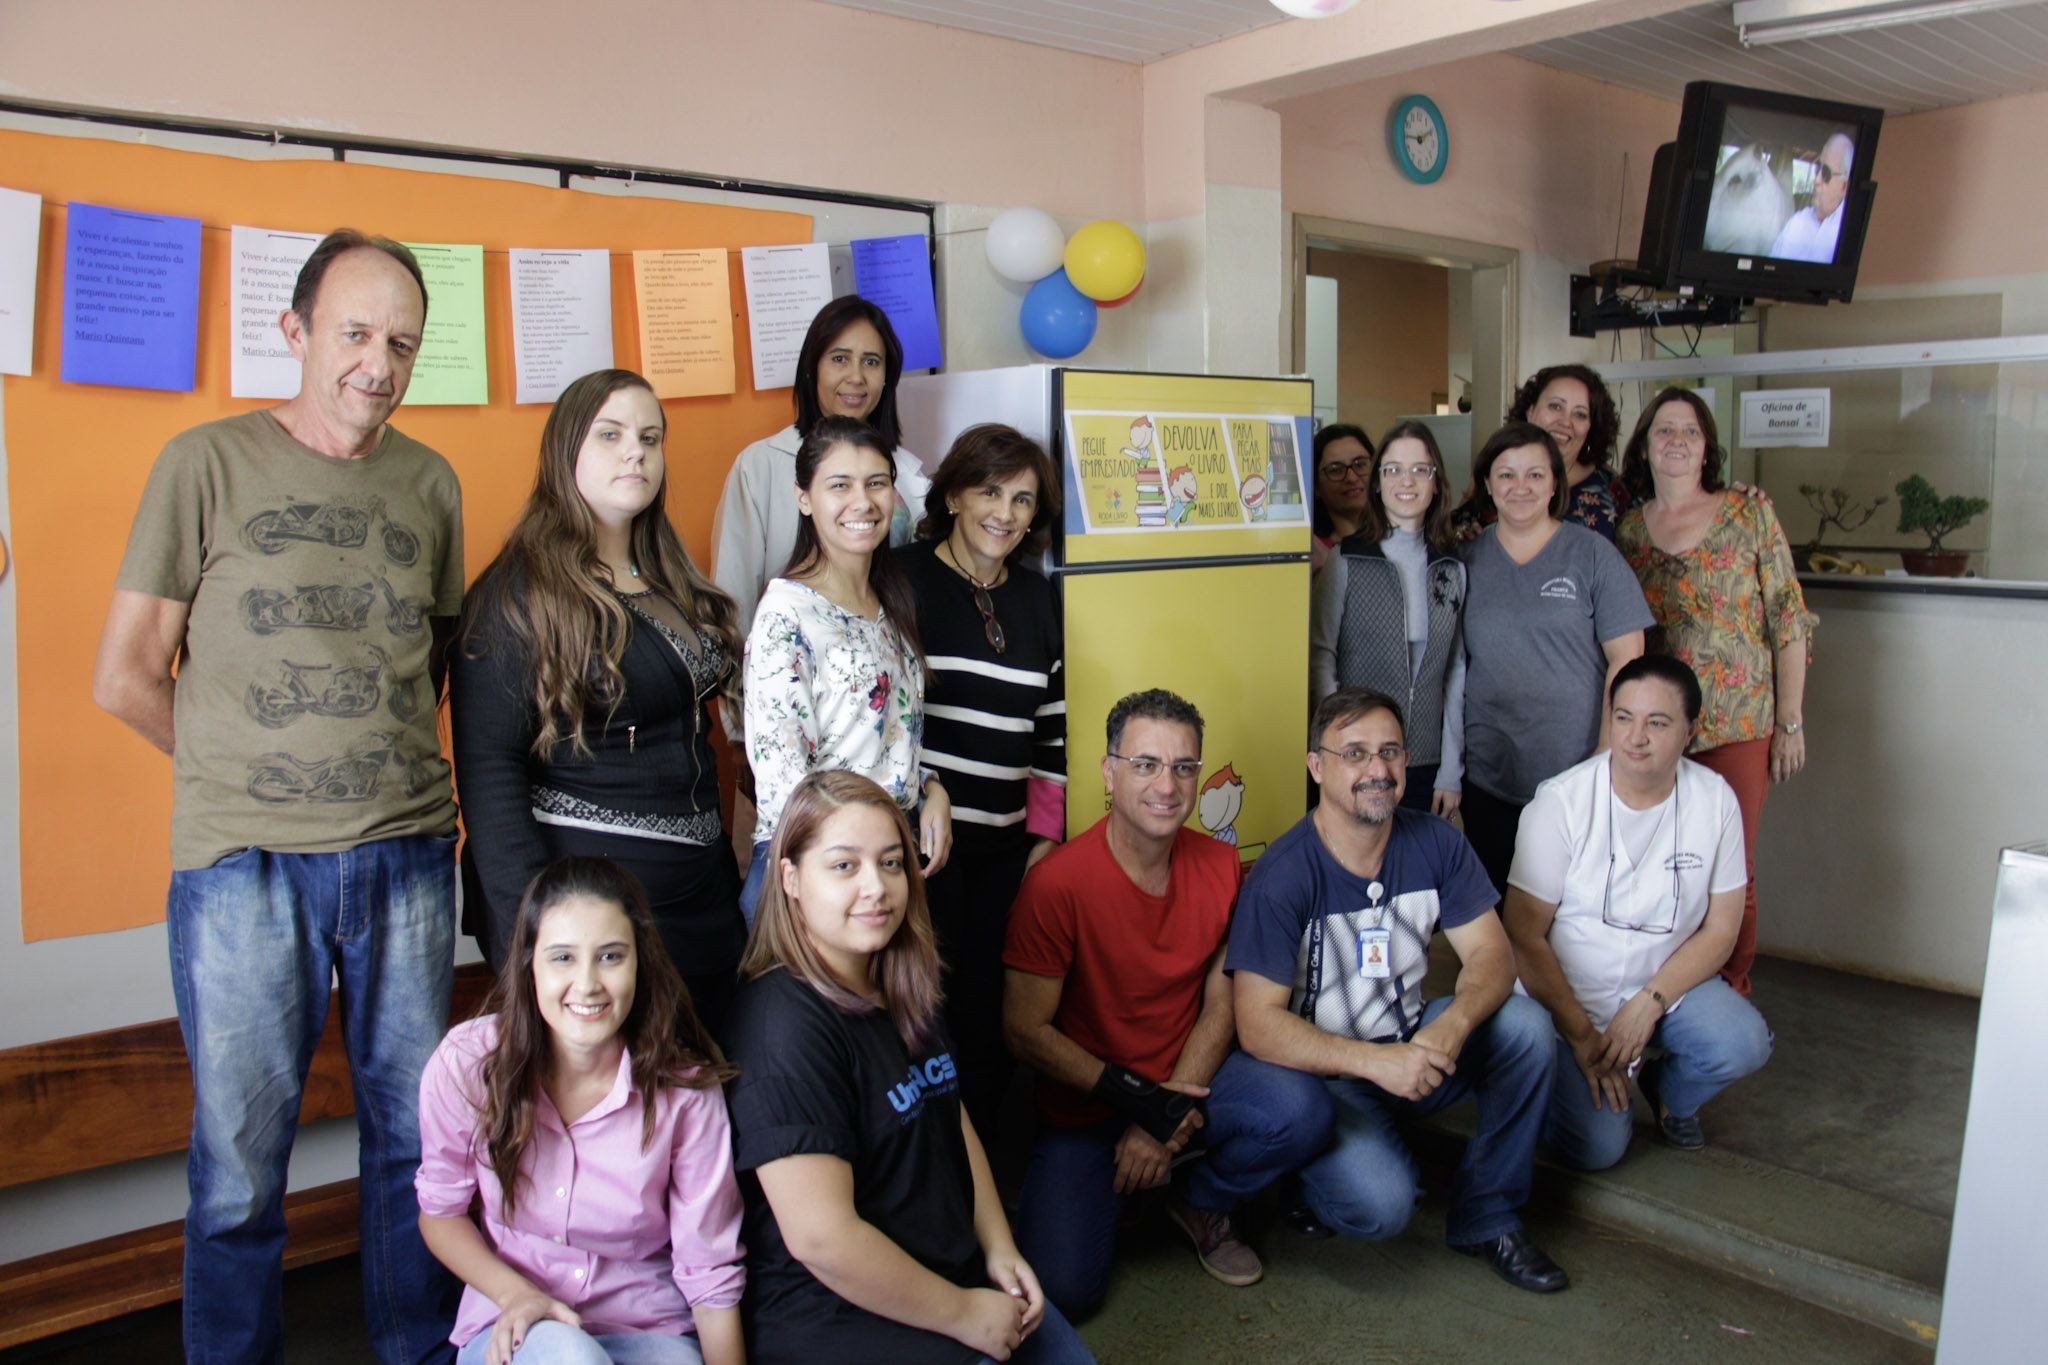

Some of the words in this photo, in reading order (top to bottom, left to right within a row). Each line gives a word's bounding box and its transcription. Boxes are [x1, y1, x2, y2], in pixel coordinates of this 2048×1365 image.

[78, 230, 101, 241] Viver
[111, 235, 150, 247] acalentar
[154, 240, 183, 250] sonhos
[84, 247, 134, 260] esperanças,
[137, 251, 170, 264] fazendo
[172, 254, 184, 264] da
[242, 252, 262, 261] Viver
[264, 254, 269, 262] é
[95, 262, 120, 271] nossa
[123, 264, 167, 277] inspiração
[248, 267, 292, 277] esperanças,
[116, 278, 143, 288] buscar
[147, 282, 162, 290] nas
[242, 278, 249, 286] fé
[76, 287, 116, 298] pequenas
[151, 296, 165, 304] um
[268, 293, 274, 302] É
[75, 302, 105, 312] grande
[108, 304, 139, 315] motivo
[142, 309, 160, 318] para
[163, 310, 175, 318] ser
[242, 307, 277, 315] pequenas
[75, 315, 98, 325] feliz!
[242, 320, 268, 328] grande
[75, 330, 102, 342] Mario
[104, 333, 145, 345] Quintana
[242, 331, 262, 341] feliz!
[1761, 401, 1793, 413] Oficina
[1796, 401, 1807, 411] de
[1232, 422, 1253, 439] PARA
[1768, 418, 1800, 428] Bonsai
[1163, 424, 1218, 452] DEVOLVA
[1082, 436, 1106, 457] PEGUE
[1237, 439, 1260, 458] PEGAR
[1080, 458, 1136, 478] EMPRESTADO
[1189, 454, 1196, 466] O
[1198, 454, 1226, 475] LIVRO
[1242, 456, 1262, 474] MAIS
[1216, 482, 1228, 499] DOE
[1198, 502, 1215, 518] MAIS
[1217, 502, 1239, 518] LIVROS
